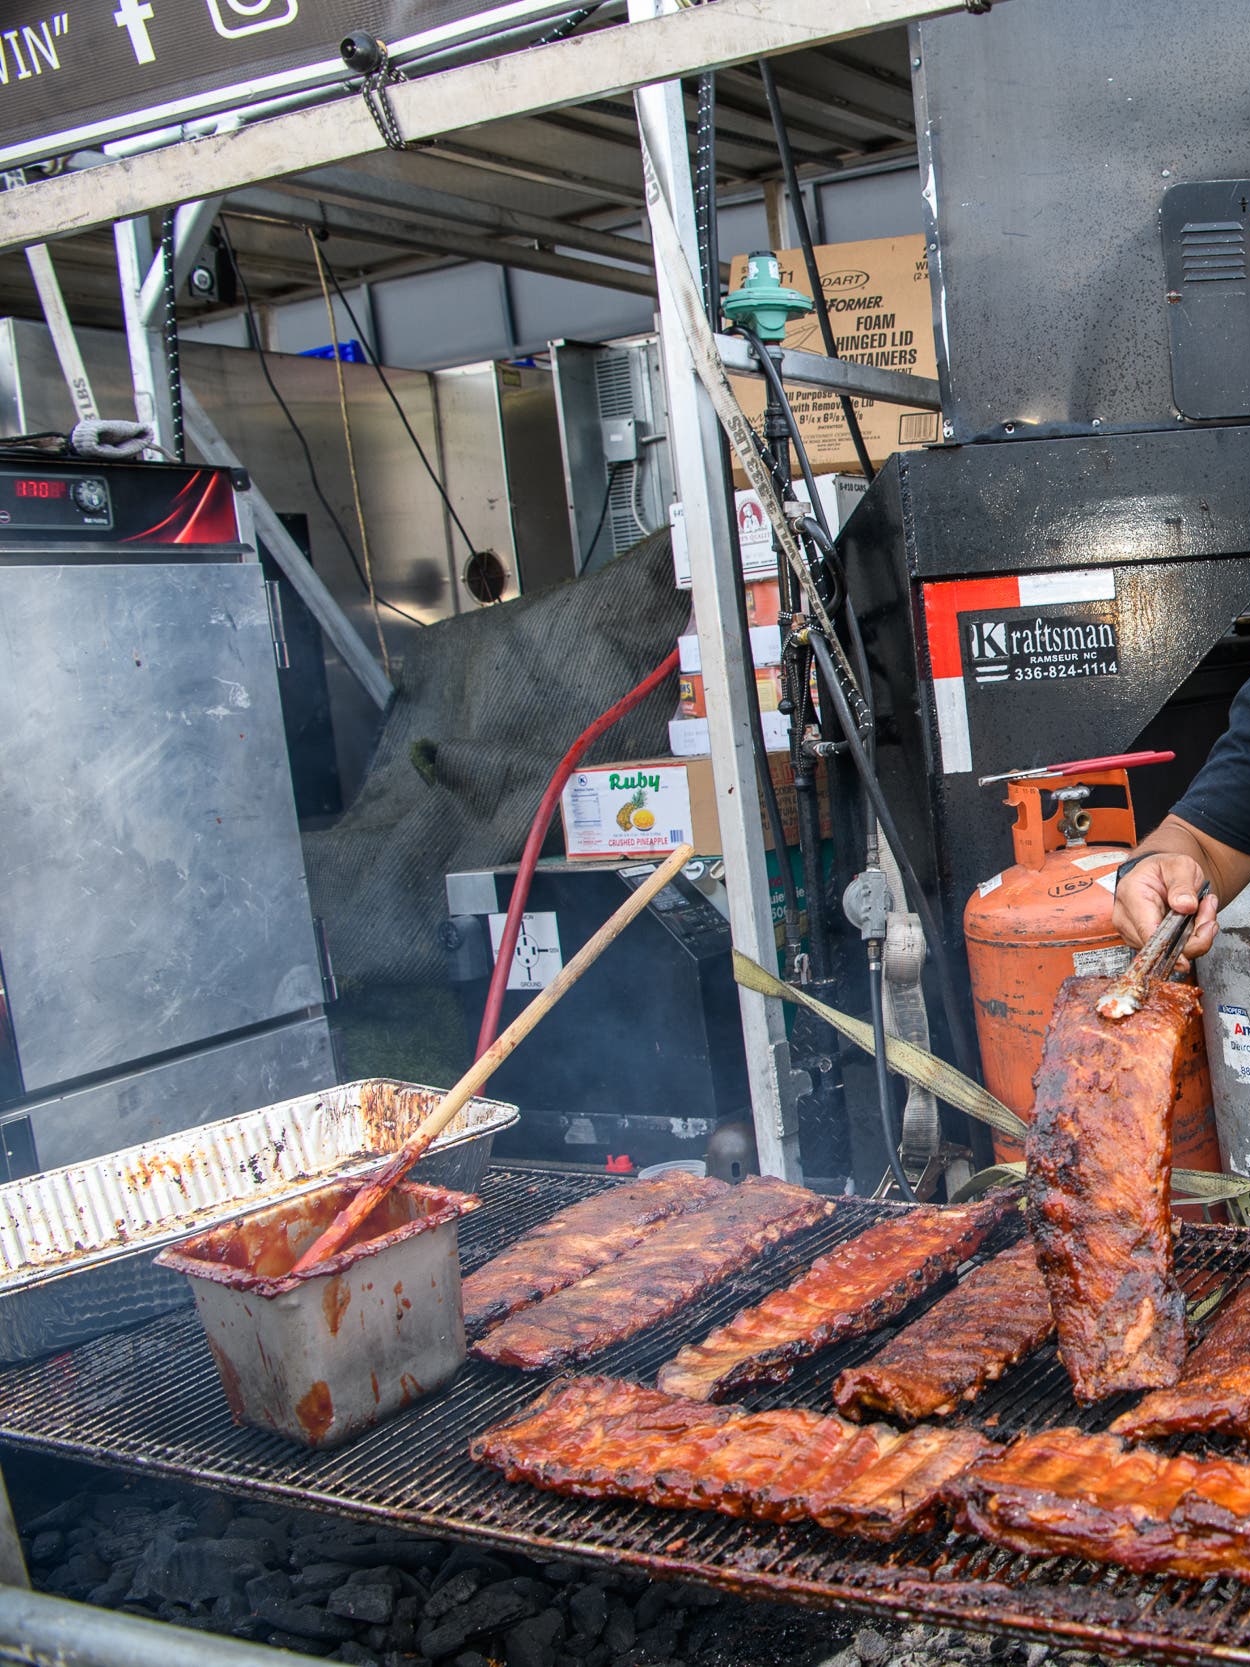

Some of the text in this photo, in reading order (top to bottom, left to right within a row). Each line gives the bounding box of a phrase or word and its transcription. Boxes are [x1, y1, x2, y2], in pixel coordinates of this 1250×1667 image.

[821, 274, 863, 287] DART
[856, 313, 895, 331] FOAM
[836, 331, 914, 351] HINGED LID
[837, 349, 917, 368] ONTAINERS
[795, 389, 832, 402] Purpose
[726, 414, 752, 455] LBS
[22, 481, 49, 498] 170
[971, 617, 1115, 660] Kraftsman
[1030, 651, 1098, 664] RAMSEUR NC
[1014, 661, 1118, 681] 336-824-1114
[609, 772, 660, 792] Ruby
[608, 837, 635, 847] CRUSHED
[636, 836, 668, 846] PINEAPPLE
